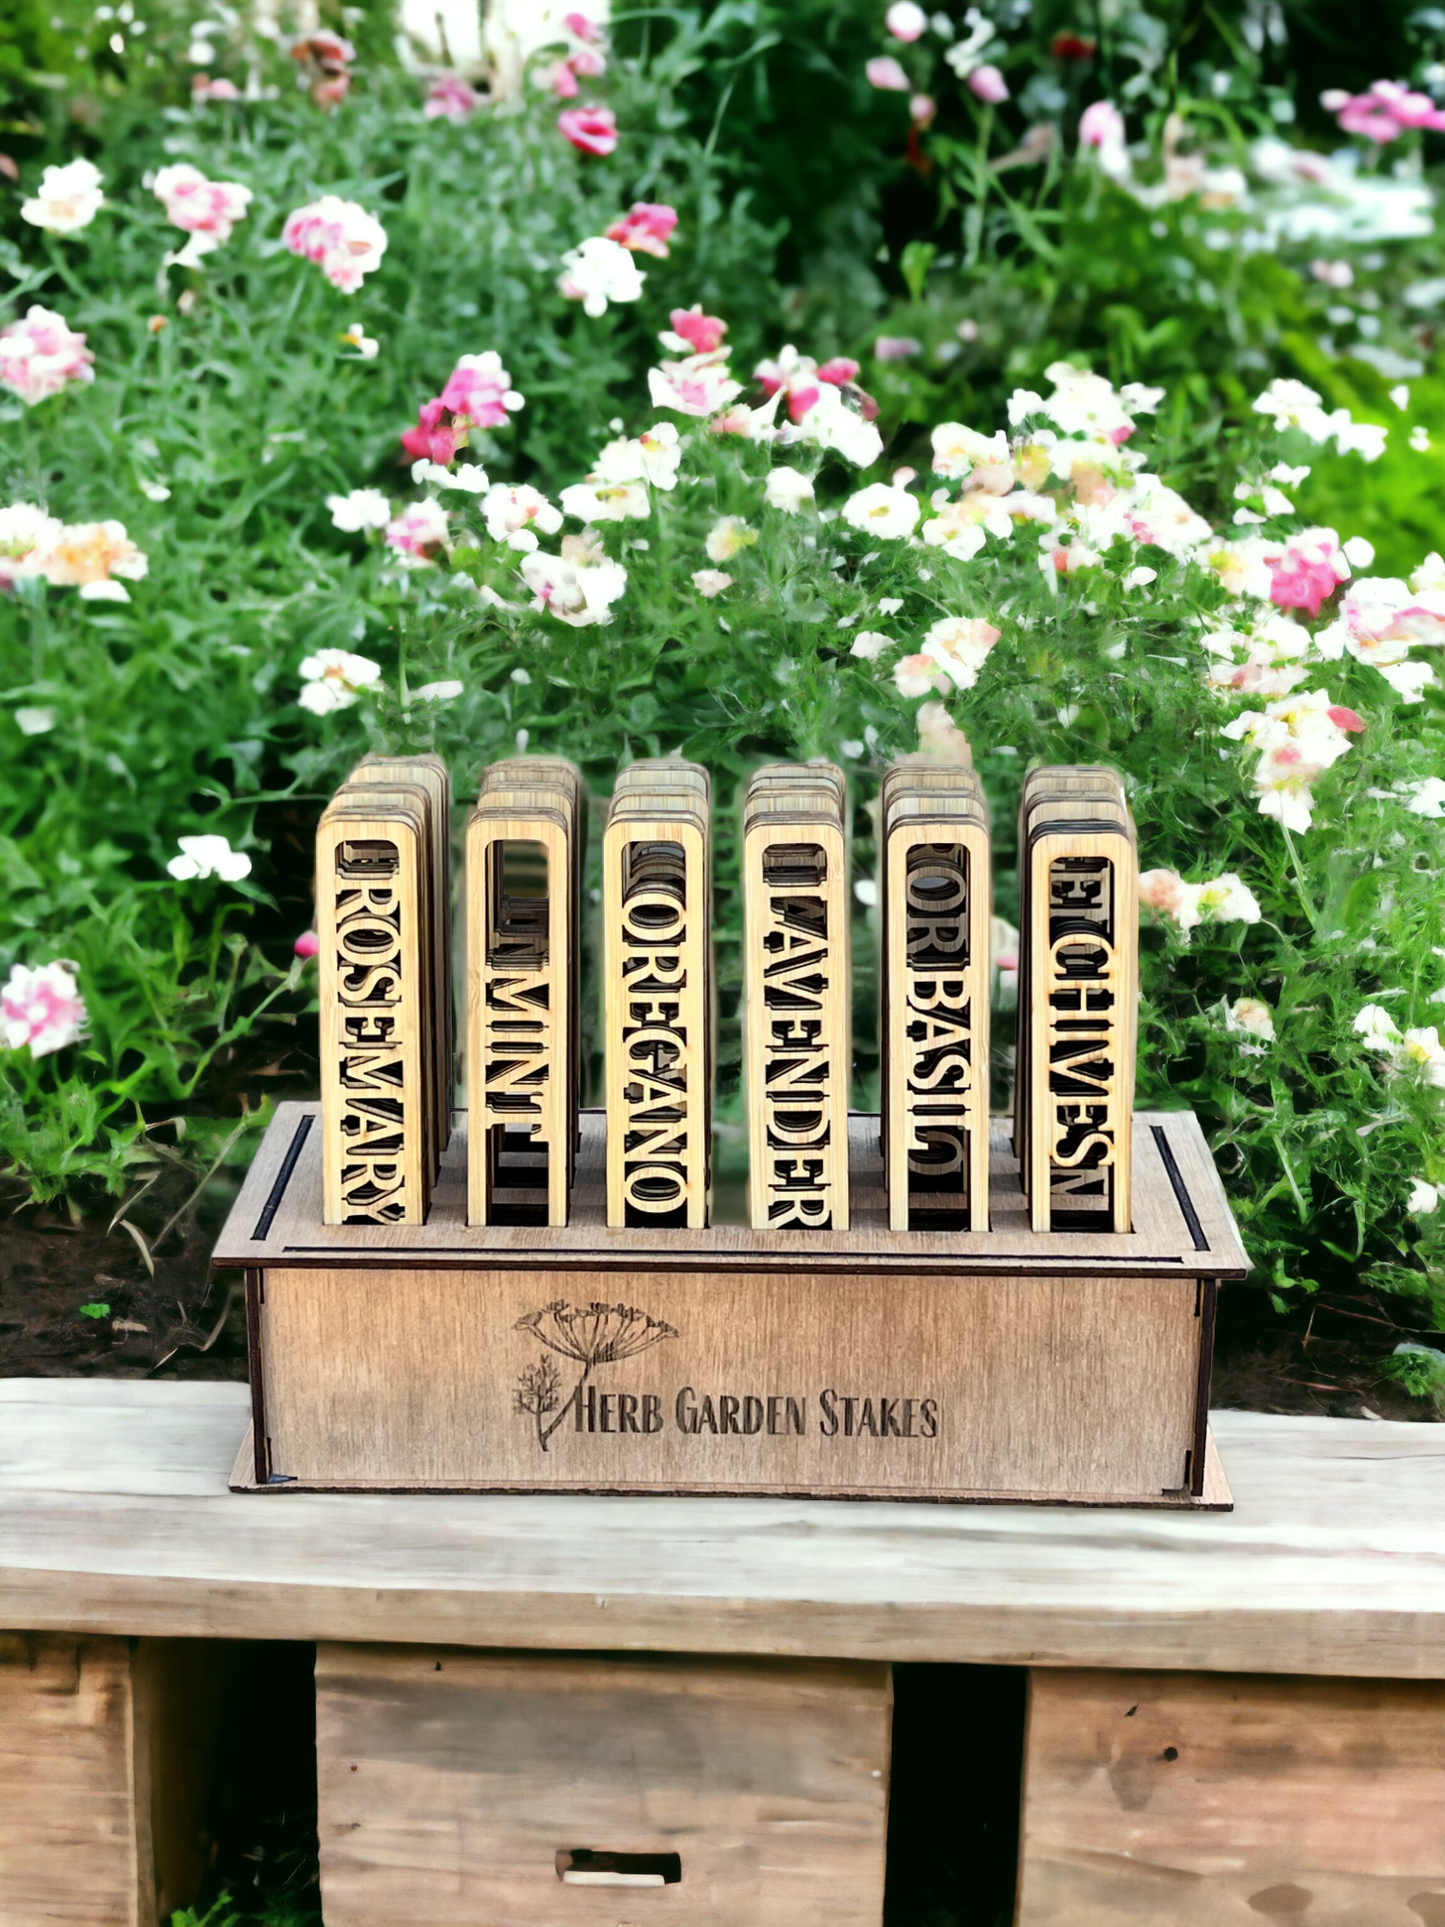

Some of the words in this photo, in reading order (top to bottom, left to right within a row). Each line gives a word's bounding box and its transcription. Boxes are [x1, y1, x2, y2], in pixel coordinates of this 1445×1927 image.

[335, 880, 406, 1225] ROSEMARY
[485, 969, 550, 1142] MINT
[622, 892, 688, 1213] OREGANO
[763, 887, 832, 1229] LAVENDER
[906, 969, 971, 1150] BASIL
[1049, 932, 1115, 1167] CHIVES
[574, 1386, 664, 1433] HERB
[676, 1386, 806, 1435] GARDEN
[820, 1388, 938, 1437] STAKES
